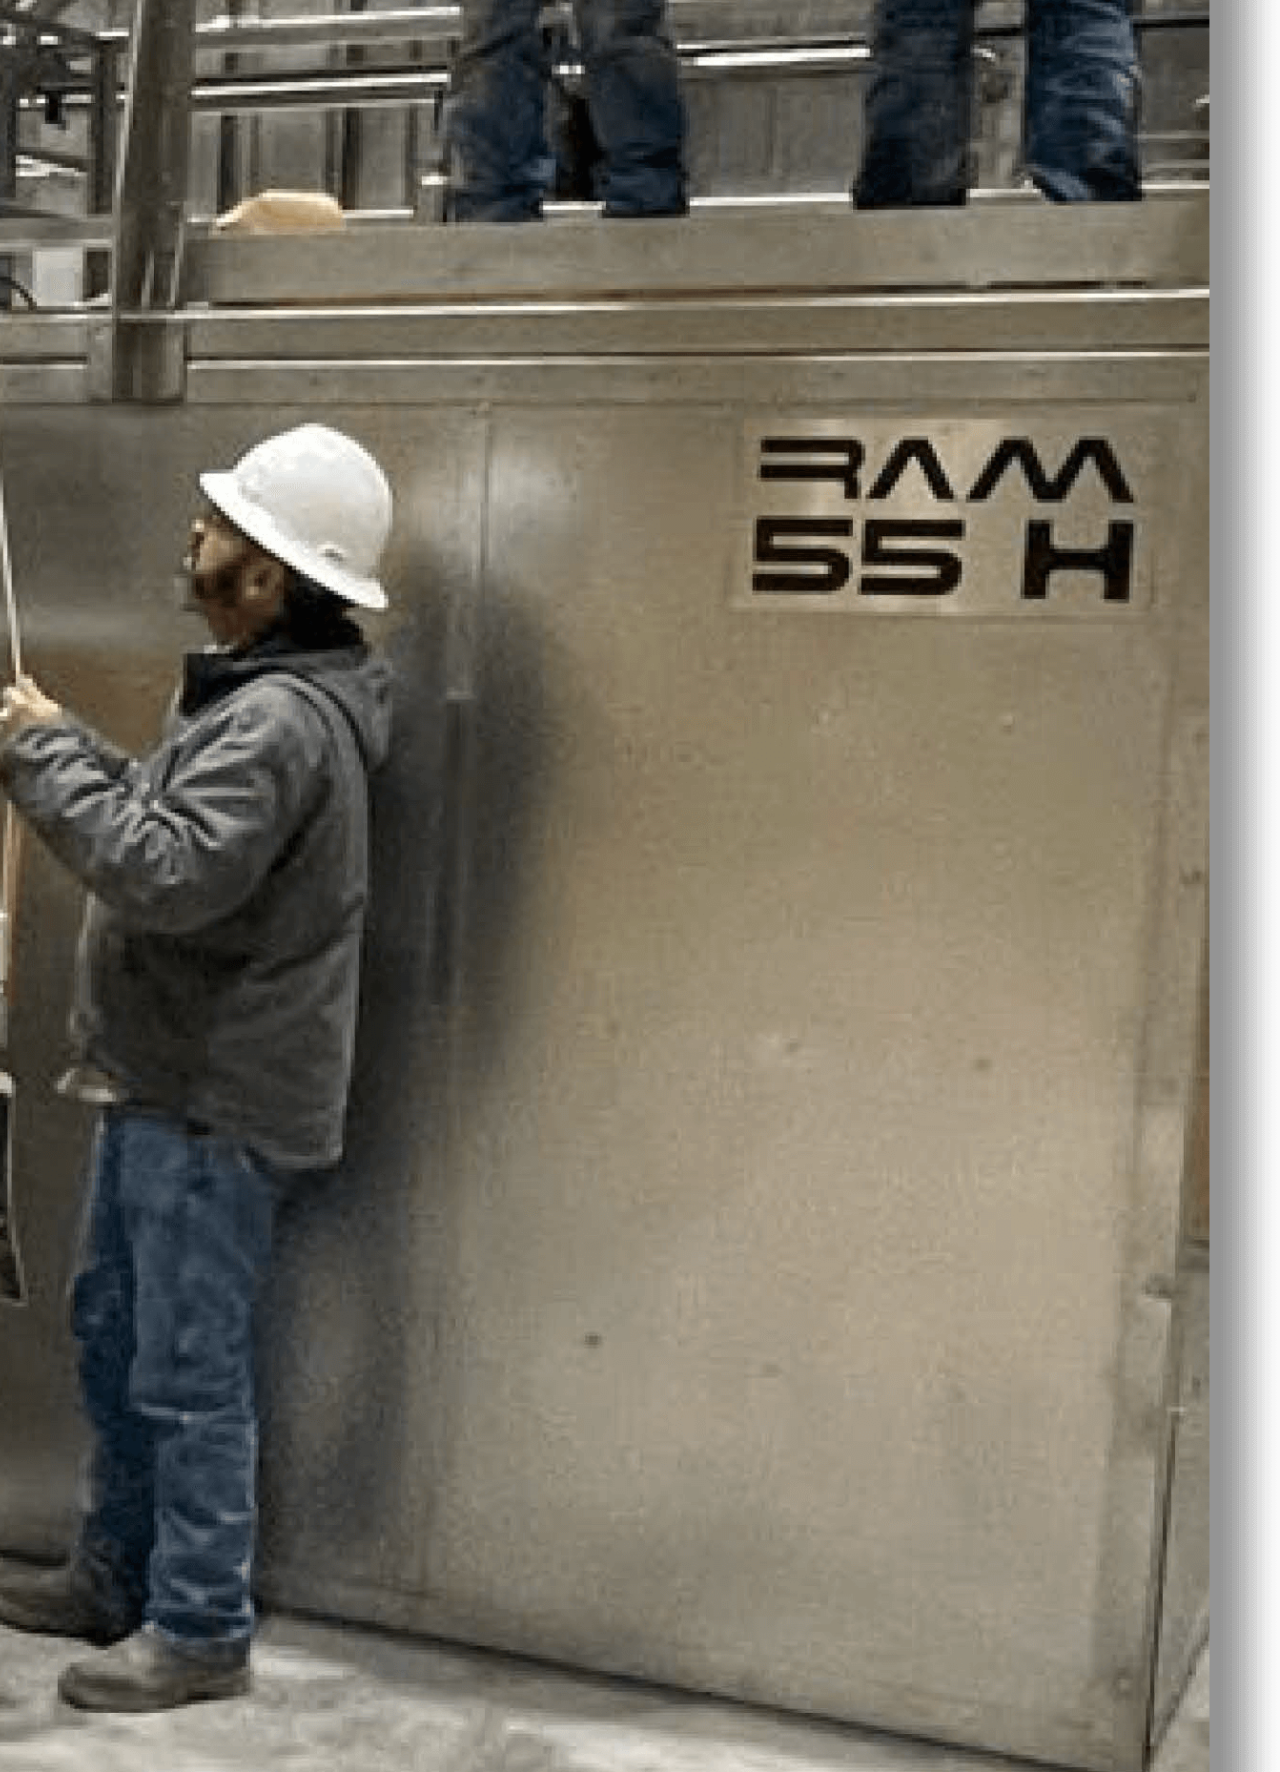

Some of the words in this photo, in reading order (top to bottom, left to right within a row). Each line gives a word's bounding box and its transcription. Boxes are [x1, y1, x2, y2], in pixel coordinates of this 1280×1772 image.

[759, 436, 1134, 503] RAM
[751, 516, 966, 596] 55
[1022, 519, 1134, 602] H
